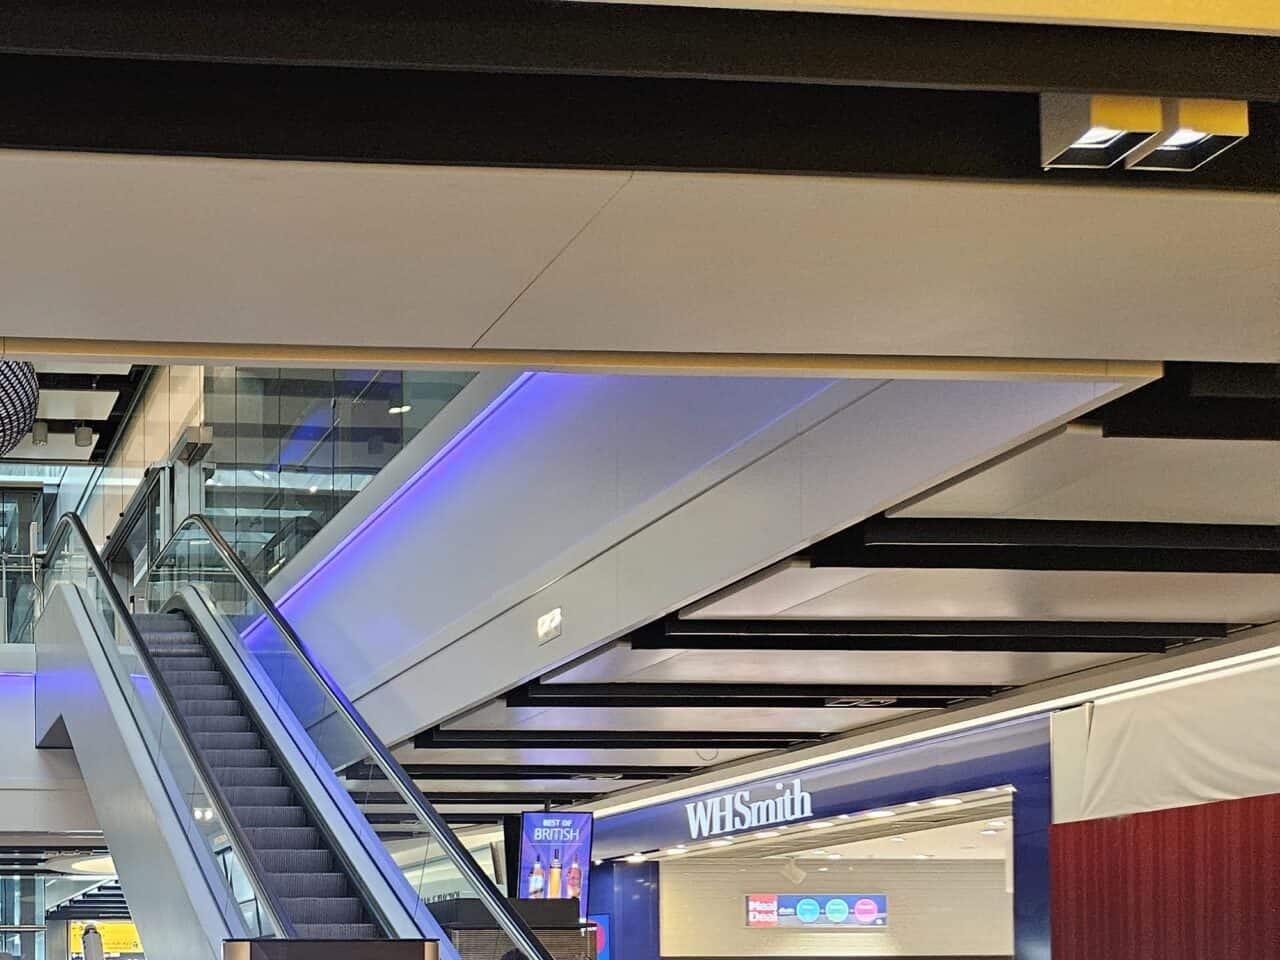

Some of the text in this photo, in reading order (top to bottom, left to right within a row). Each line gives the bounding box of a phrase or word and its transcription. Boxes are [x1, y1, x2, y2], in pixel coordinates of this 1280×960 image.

[684, 778, 814, 840] WHSmith
[543, 819, 573, 827] BEST OF
[534, 828, 580, 841] BRITISH
